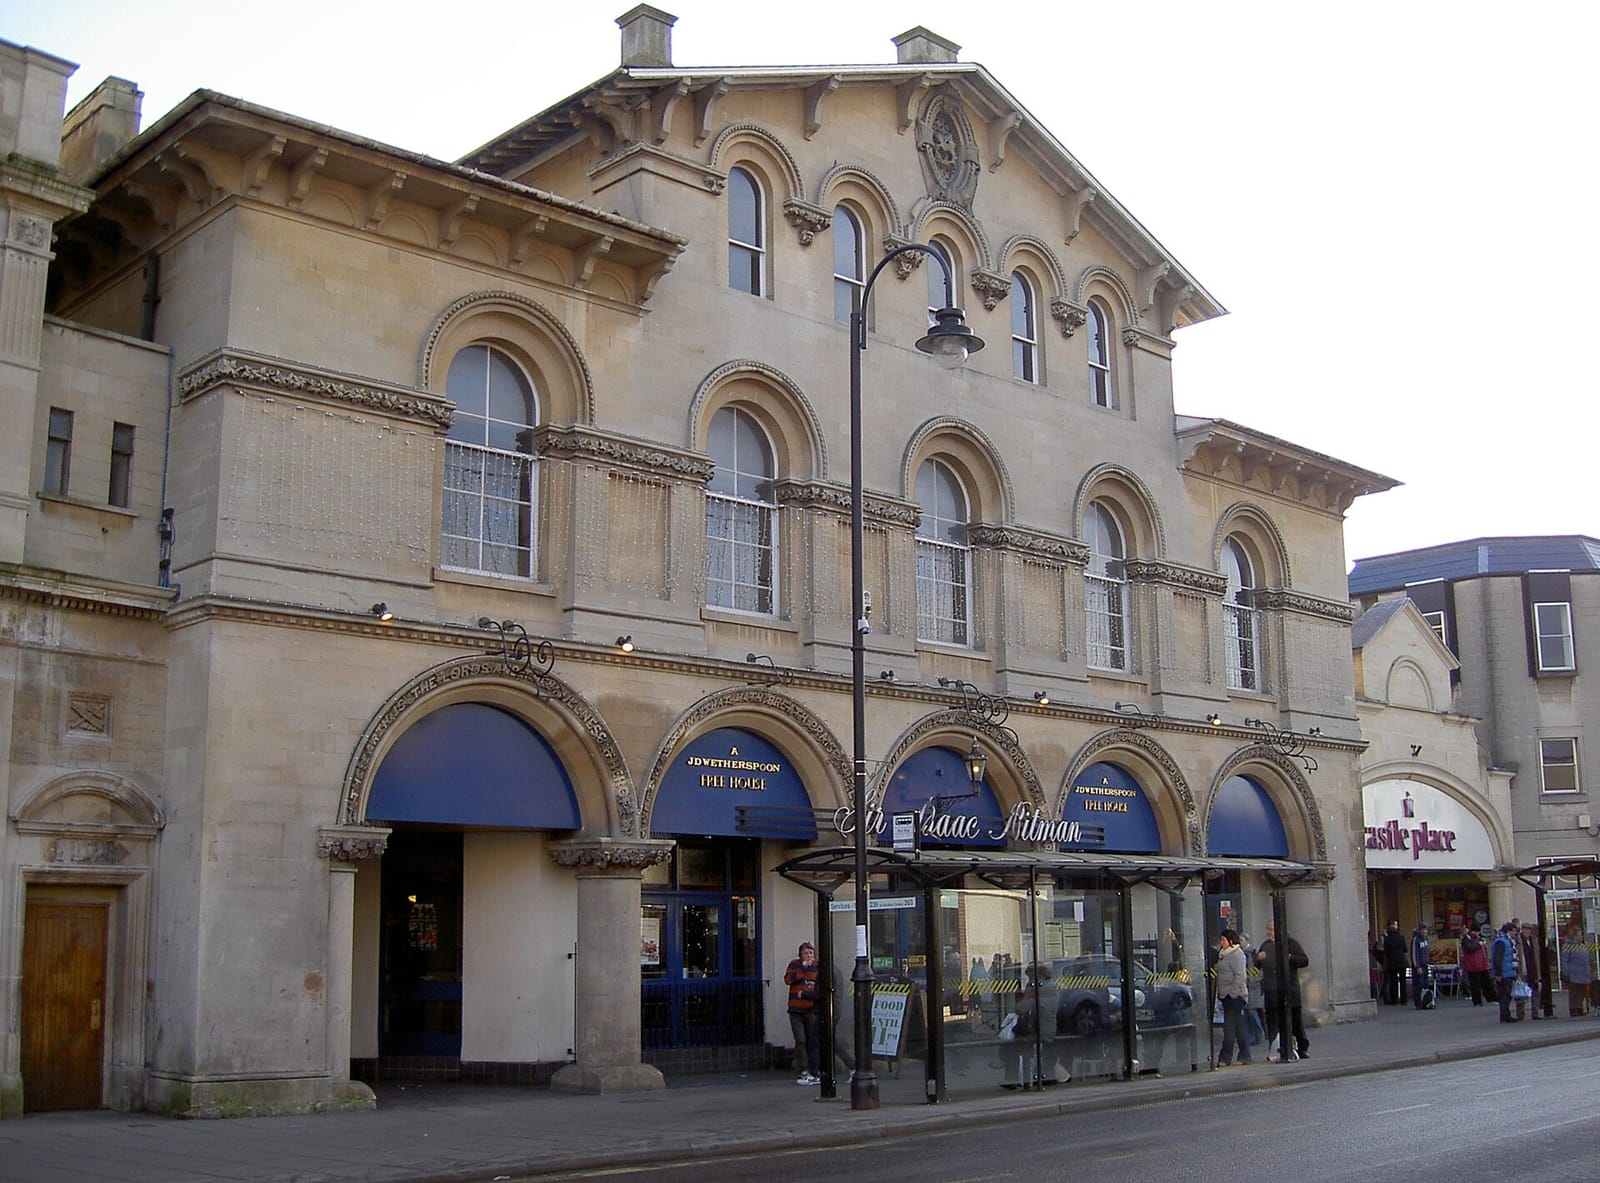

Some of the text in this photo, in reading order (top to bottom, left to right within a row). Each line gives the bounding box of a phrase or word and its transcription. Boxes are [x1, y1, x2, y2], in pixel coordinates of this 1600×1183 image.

[730, 747, 739, 756] A
[701, 774, 767, 791] FREE HOUSE
[1102, 777, 1109, 785] A
[914, 795, 981, 841] Isaac
[988, 801, 1083, 845] Pitman
[1364, 819, 1457, 861] astle place
[874, 1000, 904, 1011] FOOD
